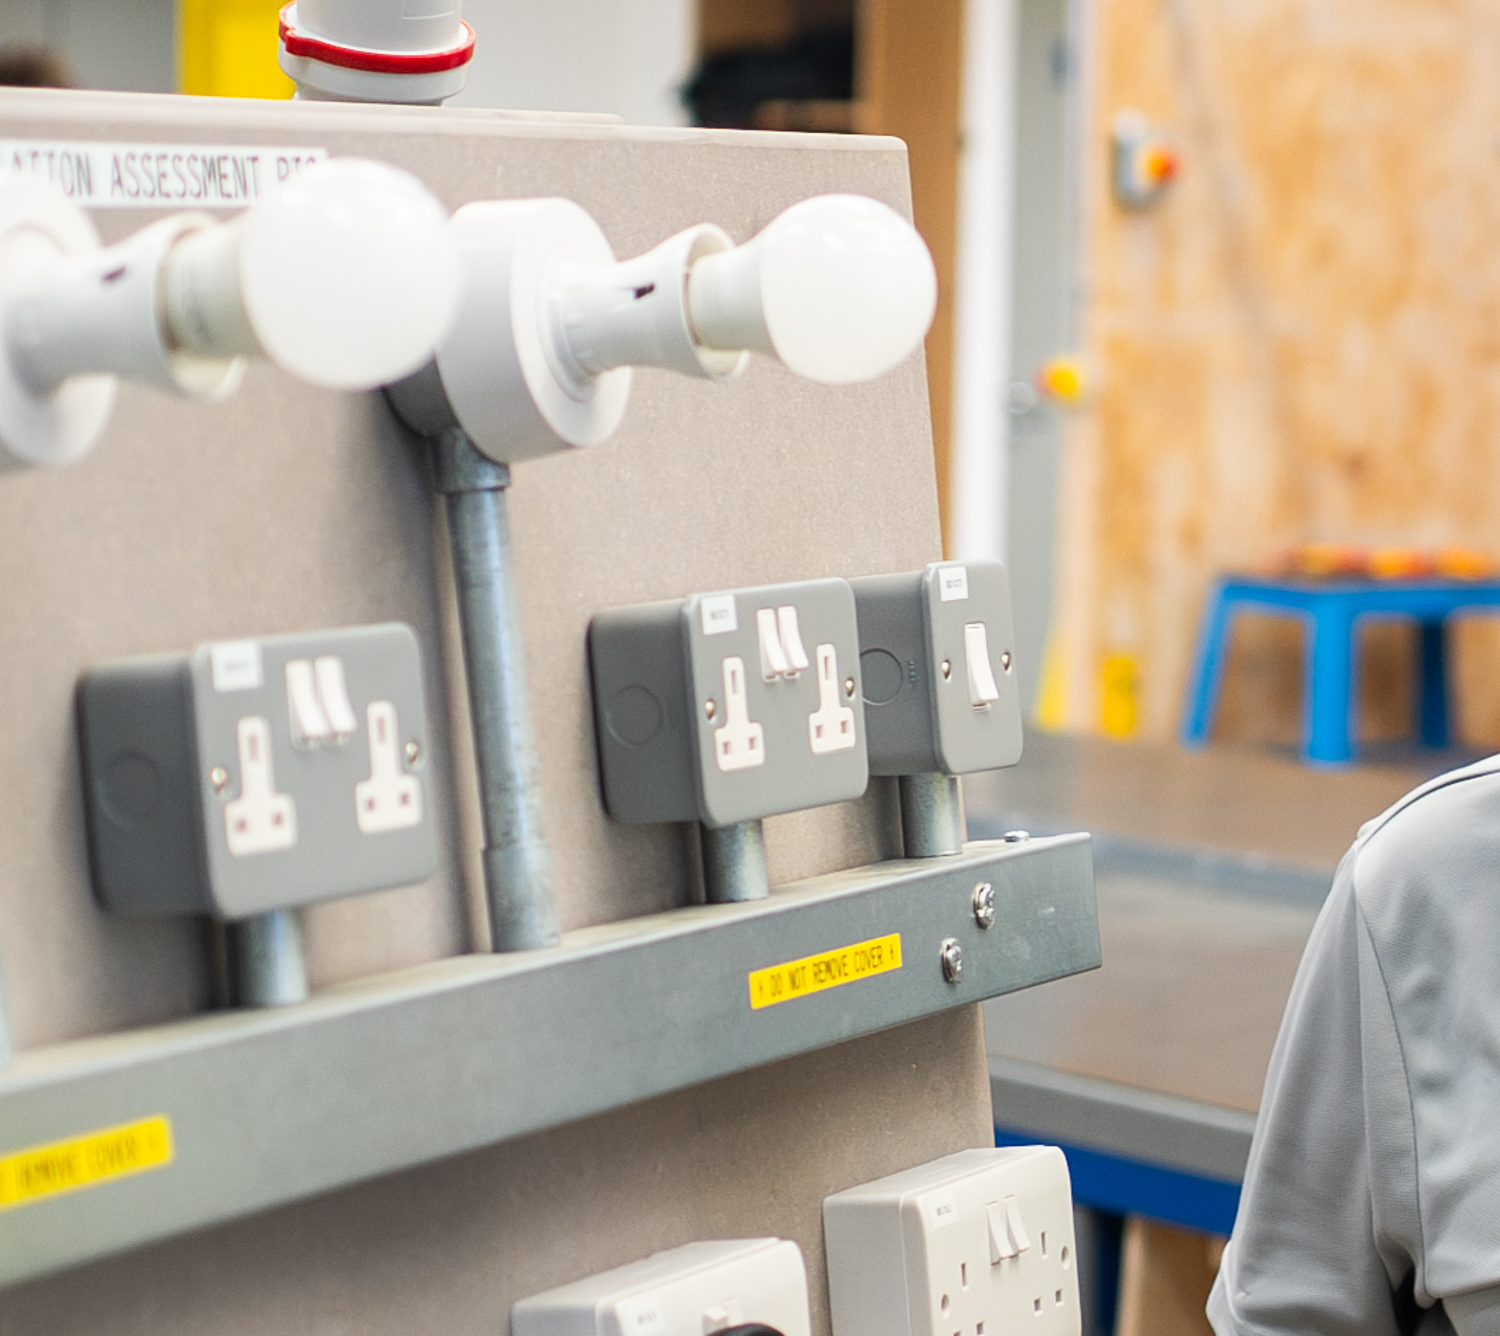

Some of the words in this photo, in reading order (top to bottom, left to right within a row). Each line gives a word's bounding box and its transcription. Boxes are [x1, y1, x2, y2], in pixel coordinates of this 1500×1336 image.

[111, 152, 259, 200] ASSESSMENT
[770, 972, 783, 998] DO
[788, 966, 807, 992] NOT
[812, 954, 849, 984] REMOVE
[854, 944, 885, 974] COVER
